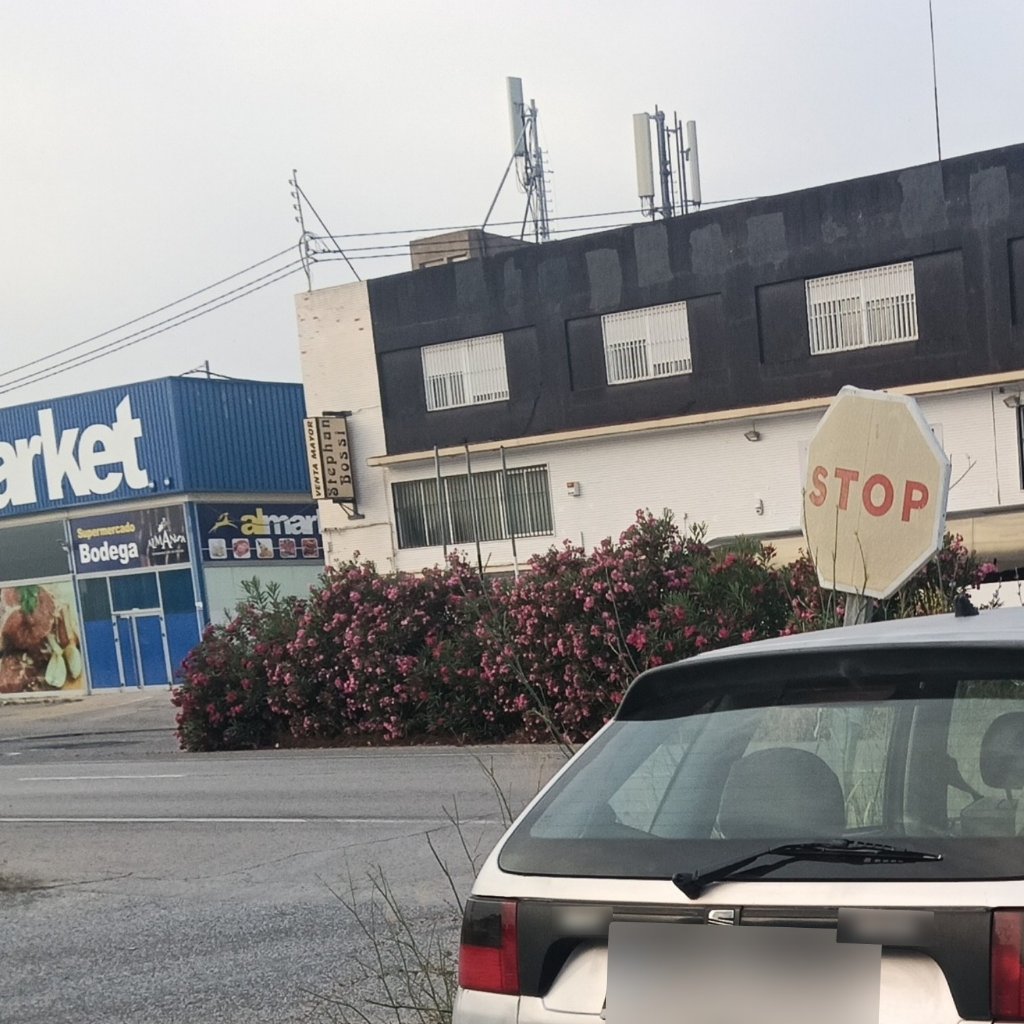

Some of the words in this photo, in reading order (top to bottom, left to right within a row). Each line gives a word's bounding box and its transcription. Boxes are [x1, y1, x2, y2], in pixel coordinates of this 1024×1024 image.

[307, 421, 317, 459] MAYOR
[322, 420, 338, 496] Stephan
[335, 431, 351, 485] Bossi
[312, 463, 321, 496] VENTA
[809, 465, 929, 522] STOP
[76, 521, 136, 540] Supermercado
[240, 508, 322, 535] almar
[79, 541, 139, 565] Bodega
